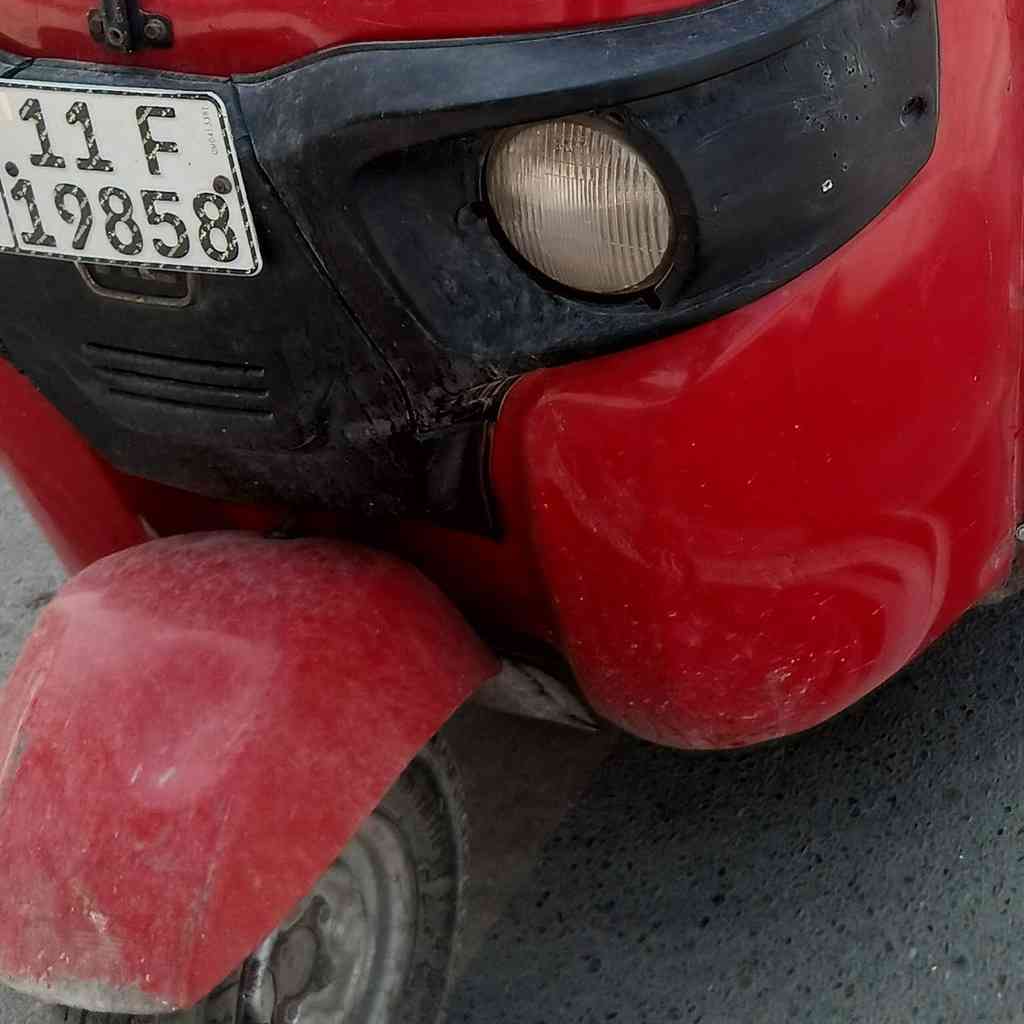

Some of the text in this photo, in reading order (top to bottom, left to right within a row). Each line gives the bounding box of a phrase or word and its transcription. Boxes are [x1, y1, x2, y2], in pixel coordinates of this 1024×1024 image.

[19, 98, 114, 172] 11
[136, 105, 178, 175] F
[11, 179, 239, 262] 19858
